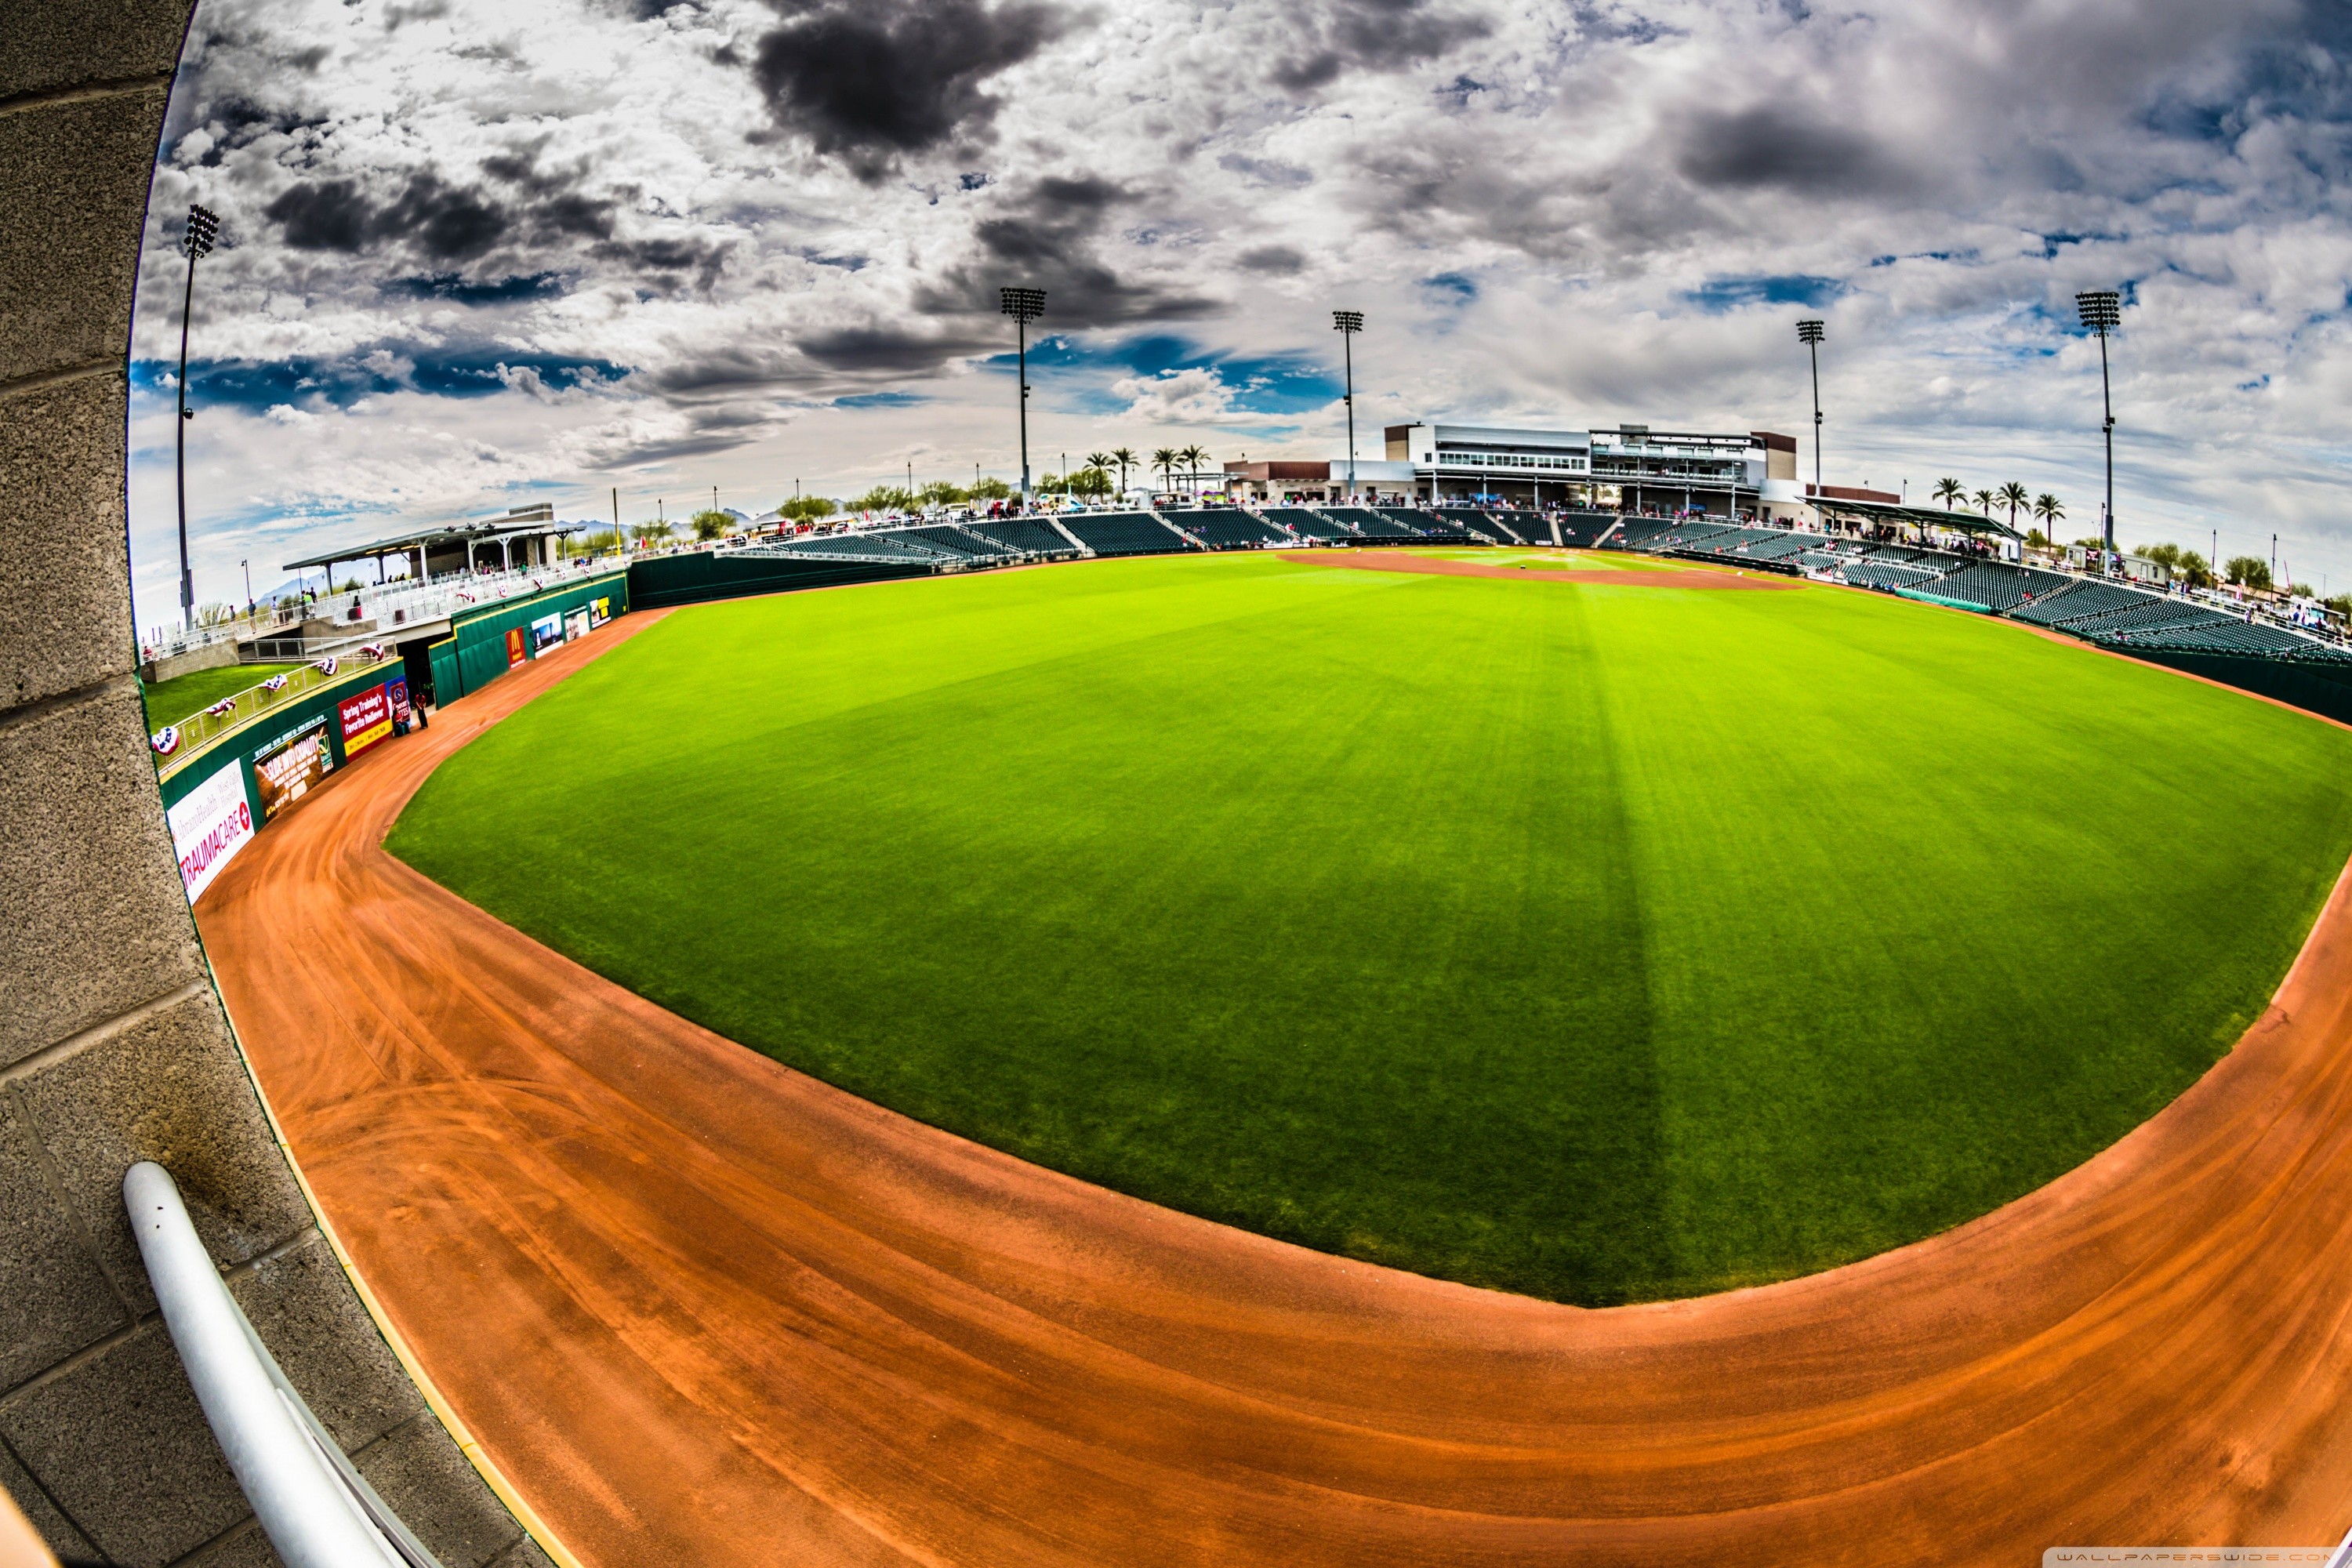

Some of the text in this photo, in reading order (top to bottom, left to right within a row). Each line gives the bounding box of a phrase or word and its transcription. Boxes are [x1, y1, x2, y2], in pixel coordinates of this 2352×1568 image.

[343, 693, 383, 720] Spring Training's
[345, 708, 384, 735] Favorite Reliever
[294, 733, 319, 763] QUALITY
[180, 810, 241, 890] TRAUMACARE
